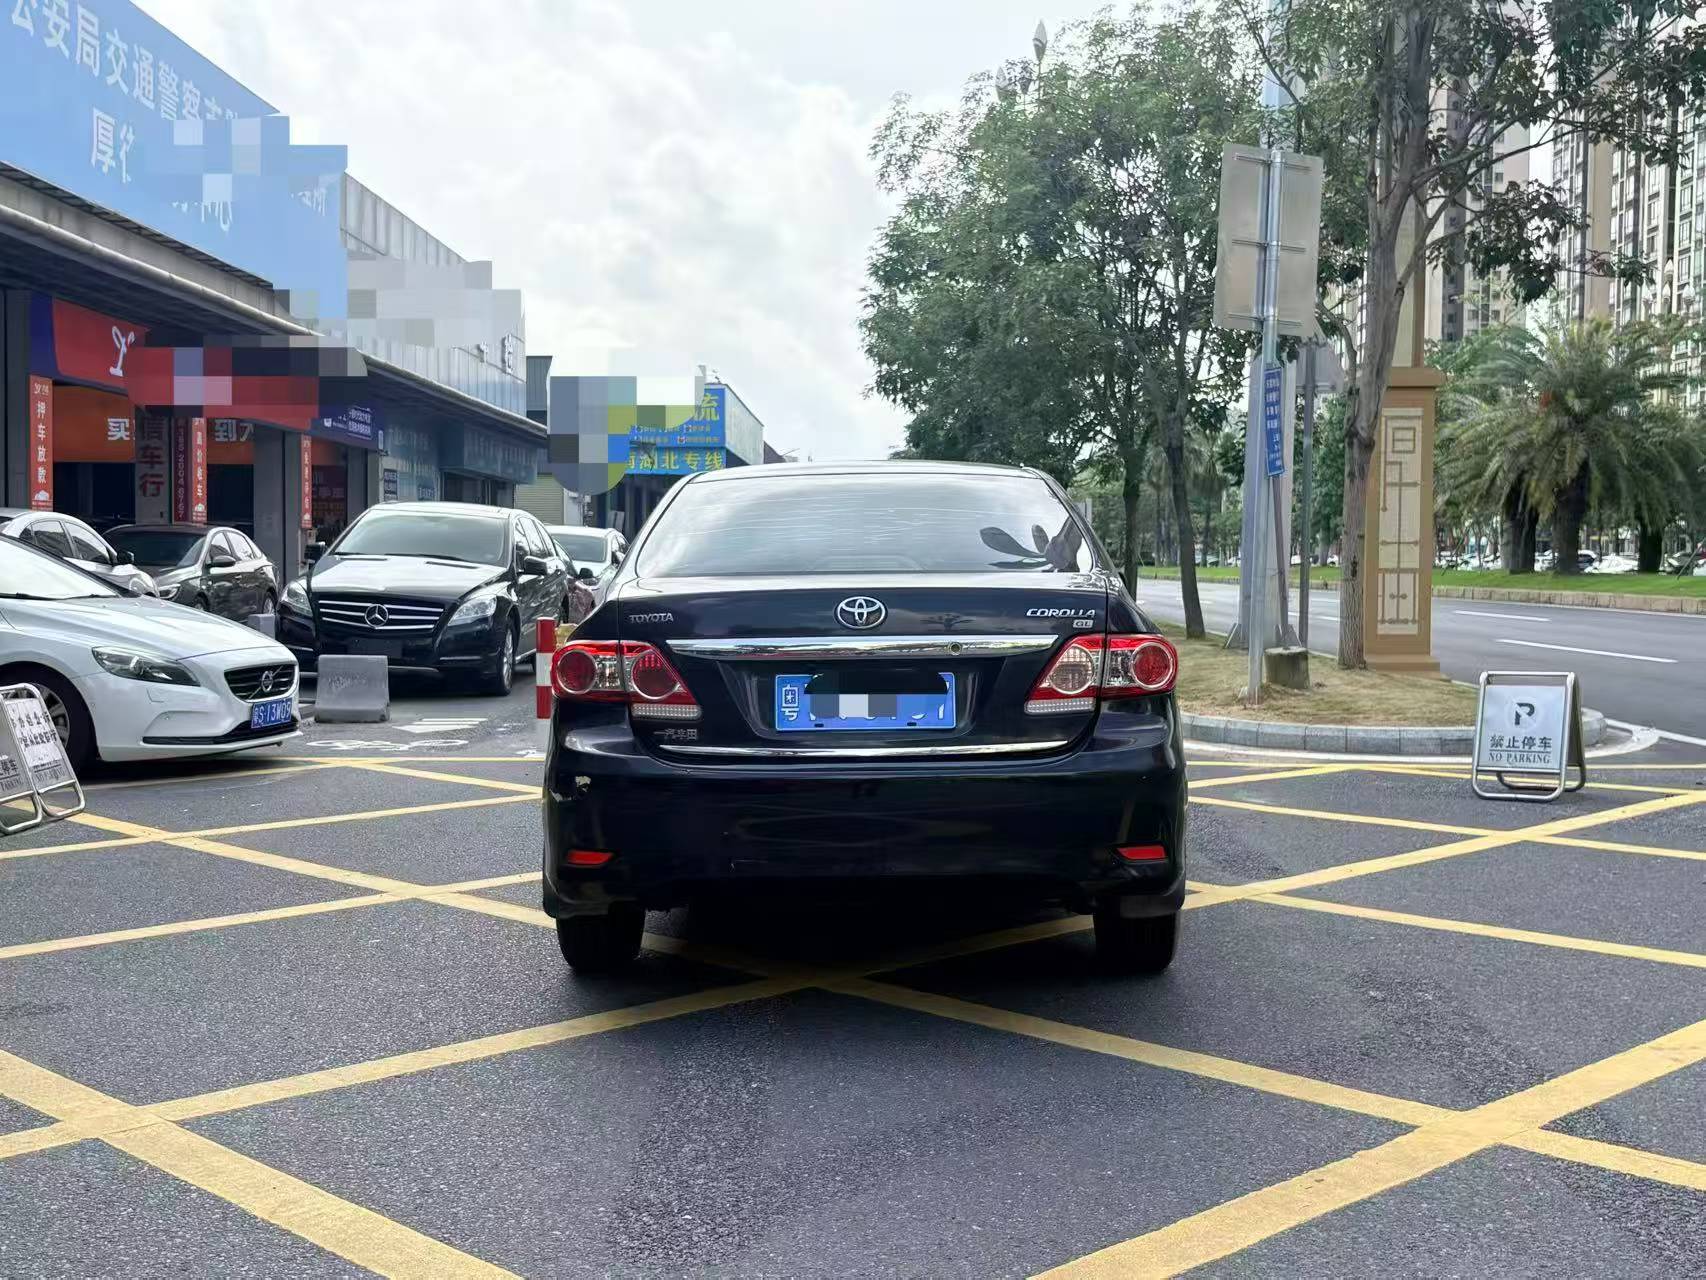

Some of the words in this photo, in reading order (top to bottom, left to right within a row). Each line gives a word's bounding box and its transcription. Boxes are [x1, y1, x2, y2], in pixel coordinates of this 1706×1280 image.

[11, 0, 238, 120] 公安局交通警察
[629, 612, 674, 623] TOYOTA
[1026, 608, 1096, 618] COROLLA
[1490, 735, 1552, 749] 禁止停车
[1489, 752, 1502, 762] NO
[1506, 753, 1550, 764] PARKING
